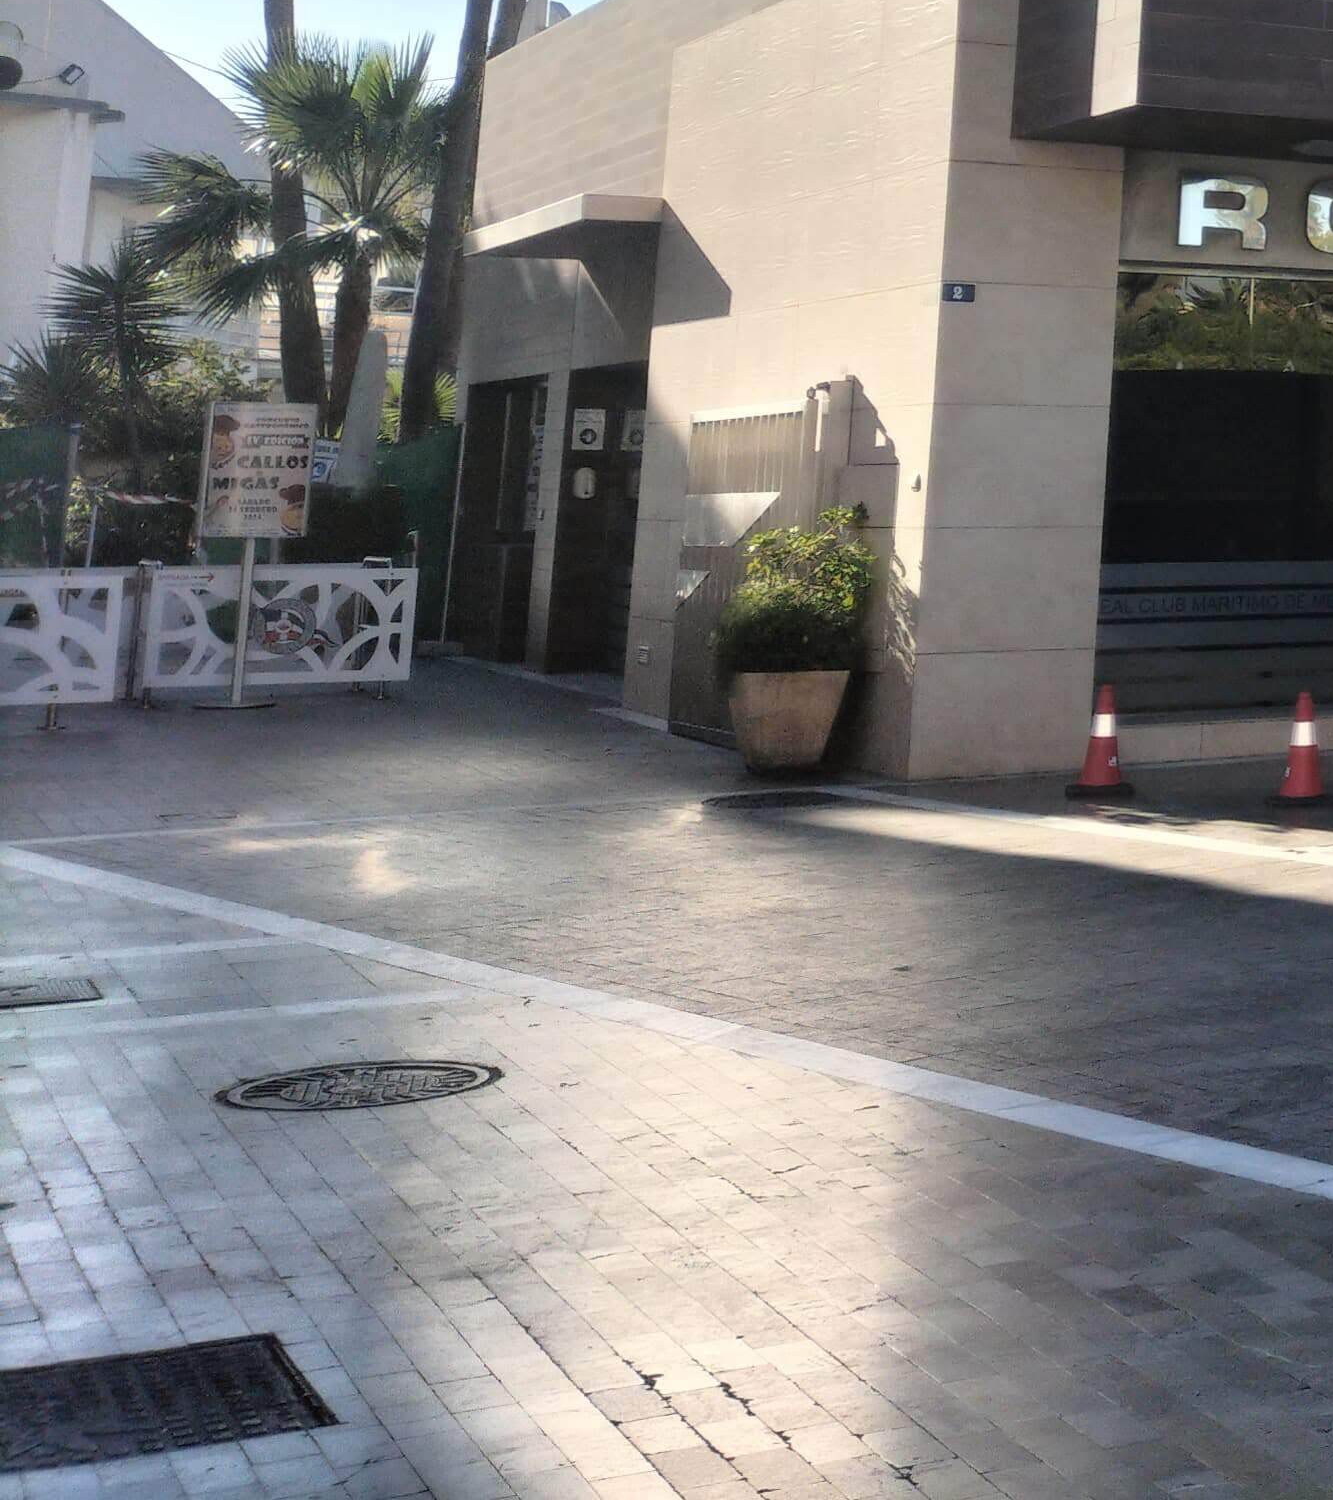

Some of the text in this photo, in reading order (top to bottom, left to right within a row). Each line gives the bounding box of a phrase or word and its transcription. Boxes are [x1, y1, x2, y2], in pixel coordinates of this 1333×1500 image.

[952, 286, 964, 300] 2
[237, 455, 310, 469] CALLOS
[212, 476, 280, 491] MIGAS
